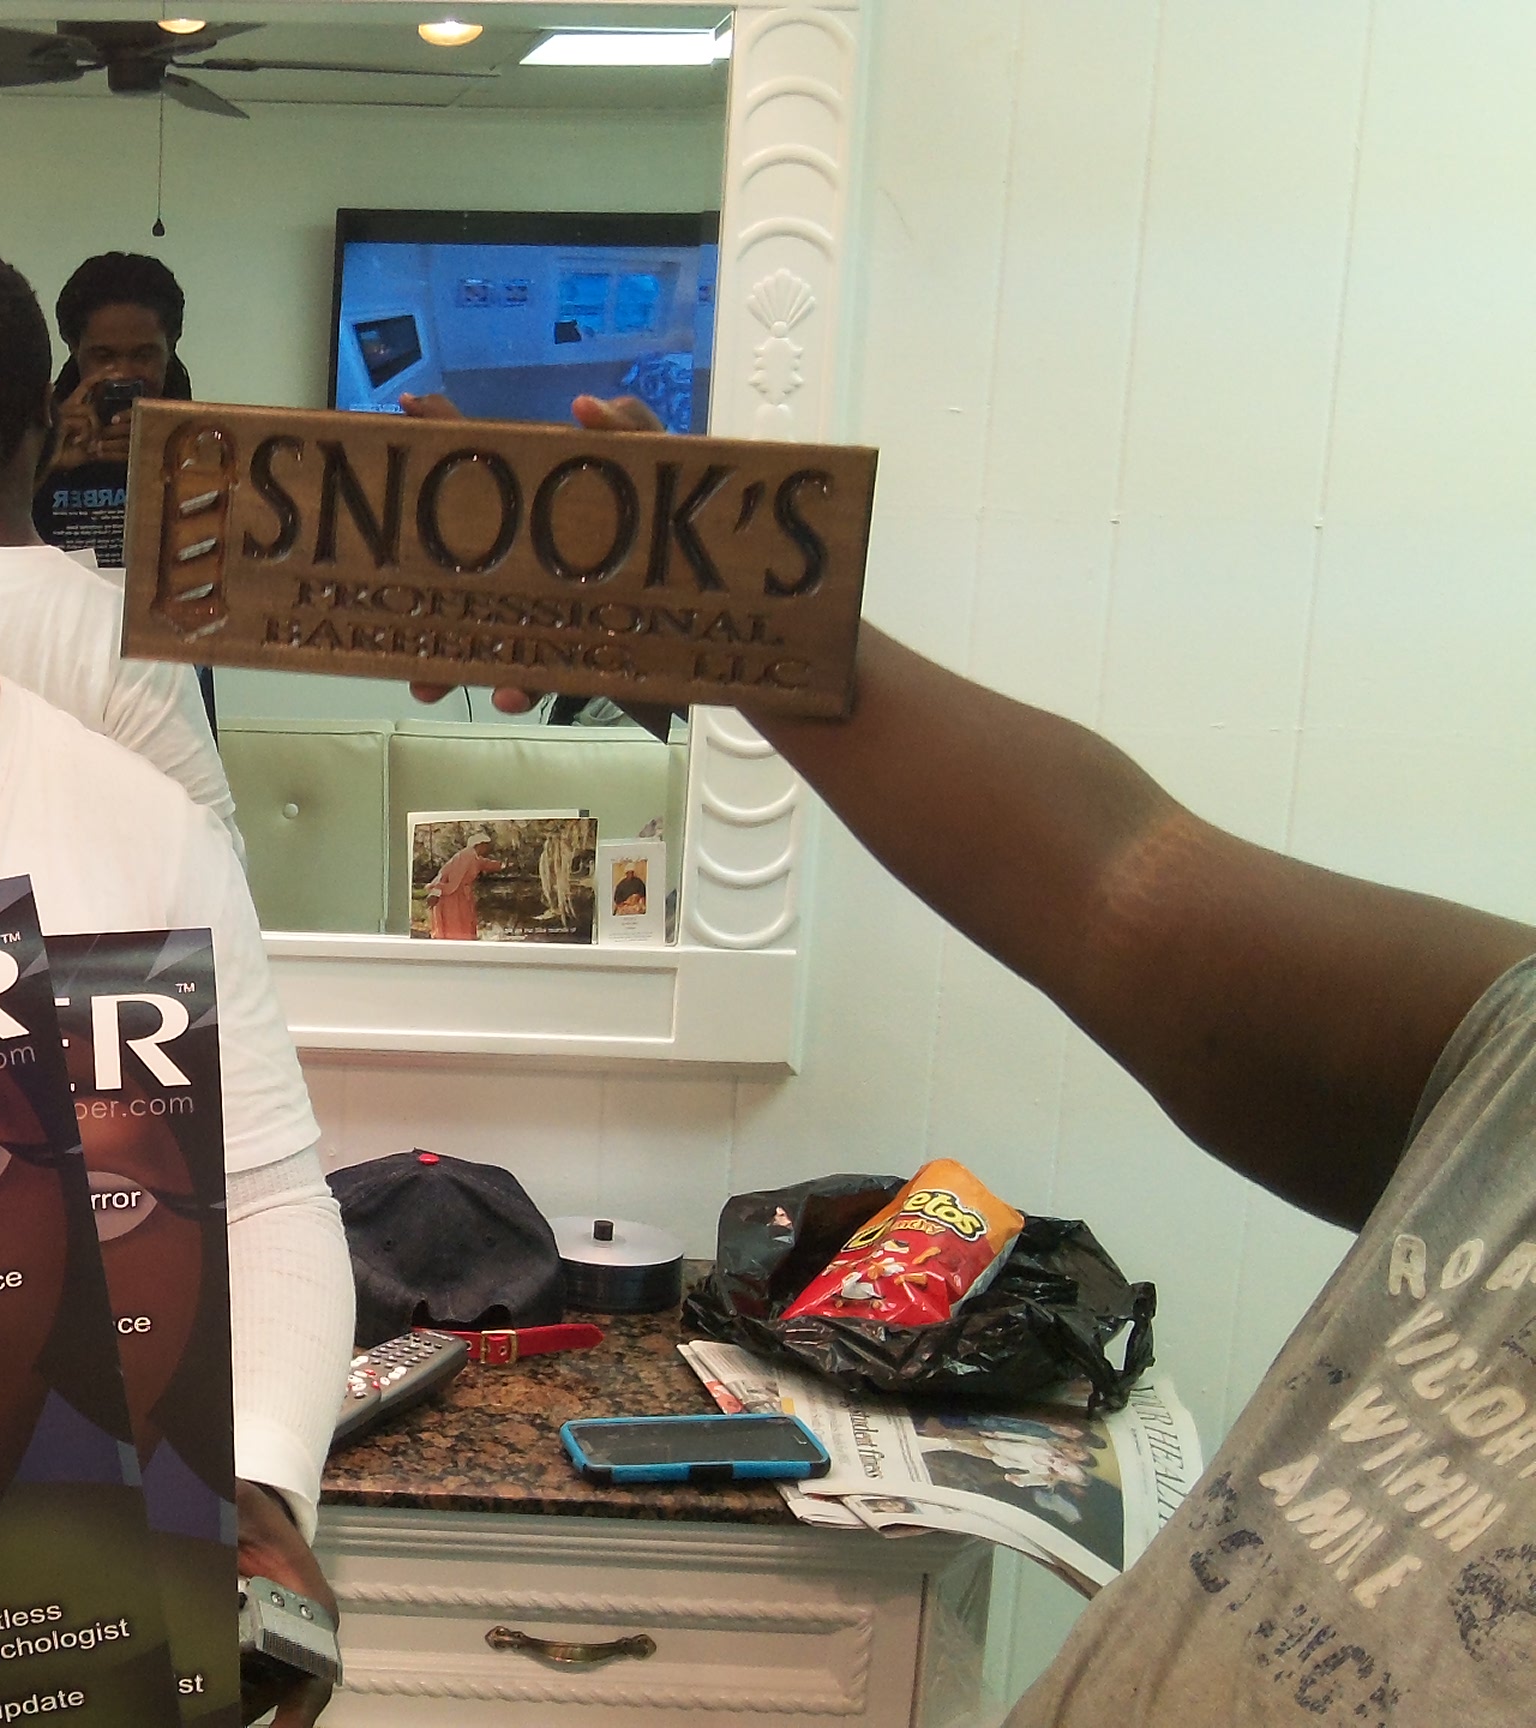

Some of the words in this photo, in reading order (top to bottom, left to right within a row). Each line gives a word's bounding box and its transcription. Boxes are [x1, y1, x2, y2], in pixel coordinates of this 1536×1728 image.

[242, 434, 835, 597] SNOOK'S
[292, 578, 783, 646] PROFESSIONAL
[688, 651, 812, 690] LLC
